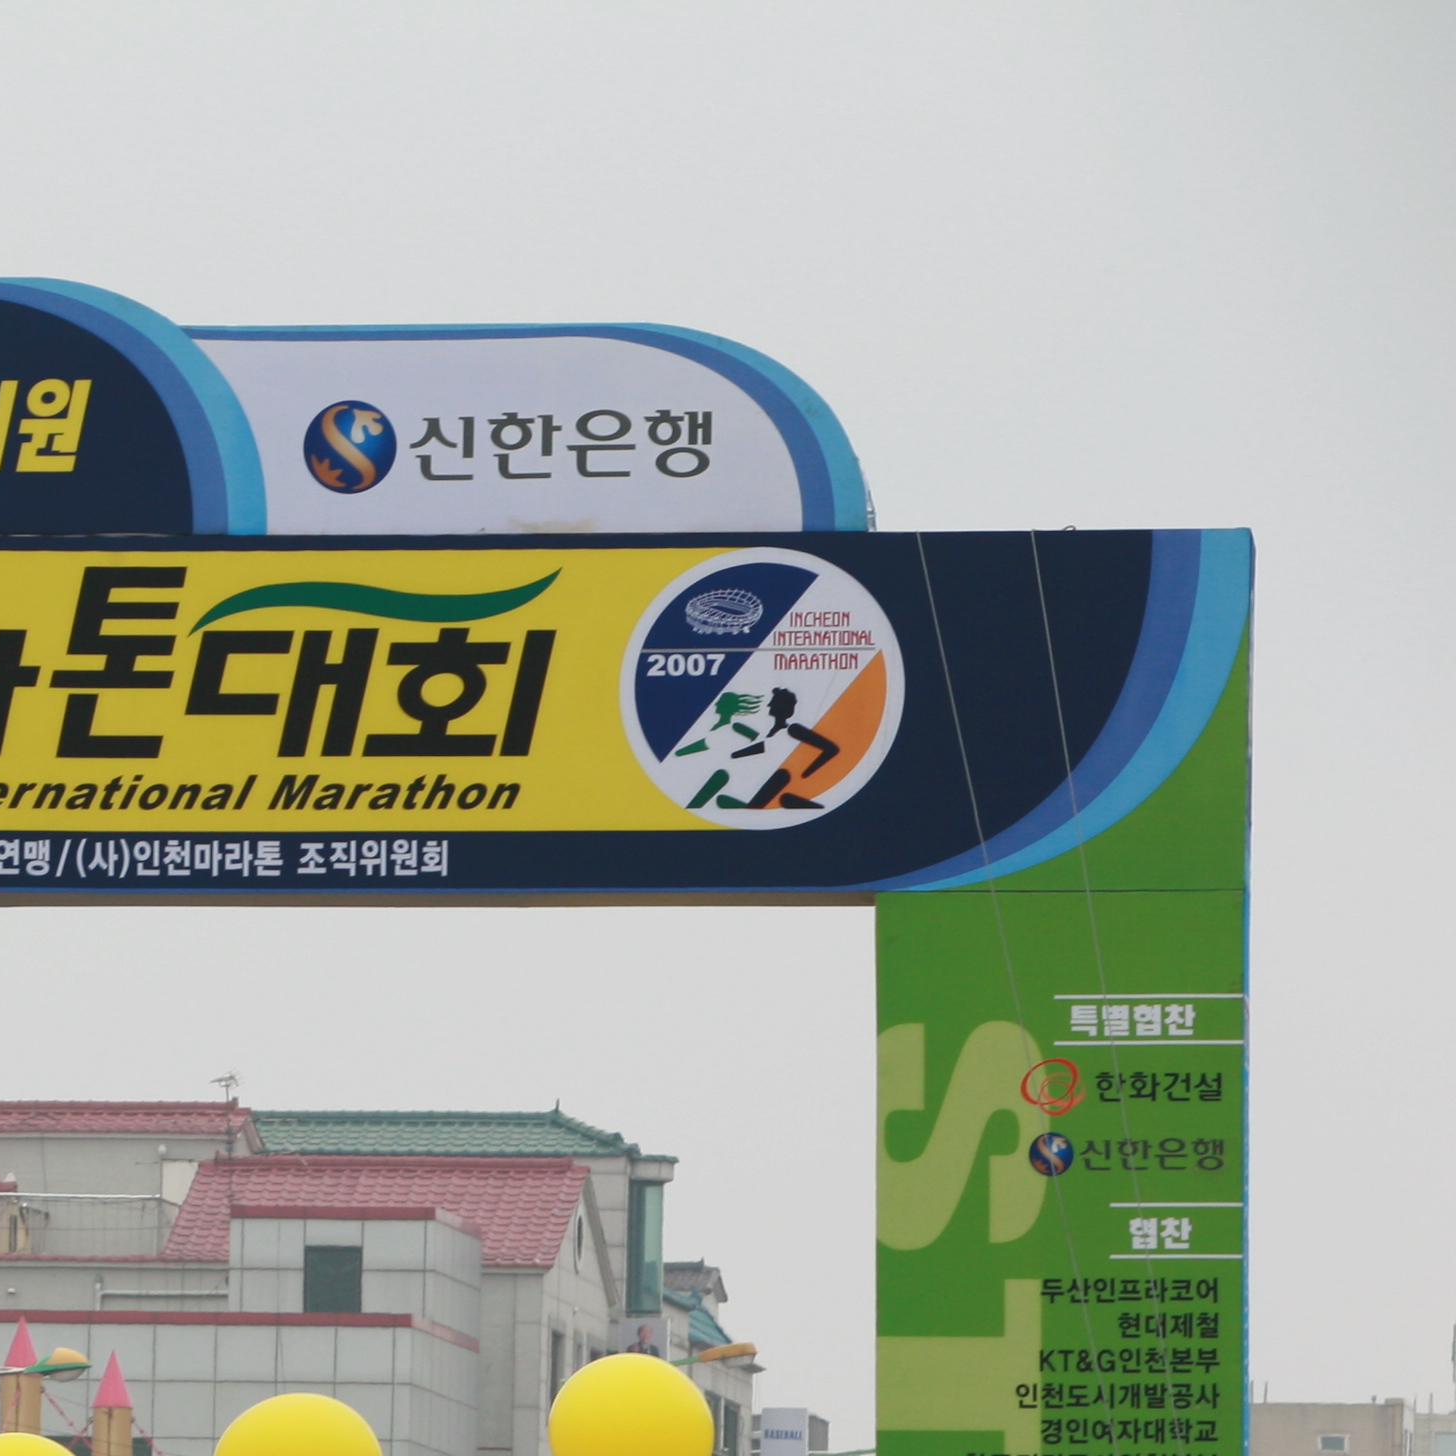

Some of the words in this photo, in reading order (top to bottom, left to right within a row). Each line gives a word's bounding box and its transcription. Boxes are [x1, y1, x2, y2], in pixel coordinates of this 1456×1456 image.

[410, 408, 715, 482] 신한은행
[790, 612, 850, 627] INCHEON
[773, 631, 875, 646] INTERNATIONAL
[646, 654, 725, 677] 2007
[774, 653, 858, 670] MARATHON
[268, 774, 520, 810] Marathon
[297, 839, 449, 877] 조직위원회
[1070, 1003, 1195, 1037] 특별협찬
[1094, 1072, 1223, 1102] 한화건설
[1079, 1137, 1225, 1171] 신한은행
[1129, 1217, 1192, 1250] 협찬
[1040, 1277, 1219, 1304] 두산인프라코어
[1118, 1312, 1220, 1339] 현대제철
[1038, 1347, 1220, 1374] KT&G인천본부
[1015, 1383, 1220, 1410] 인천도시개발공사
[1040, 1418, 1219, 1445] 경인여자대학교
